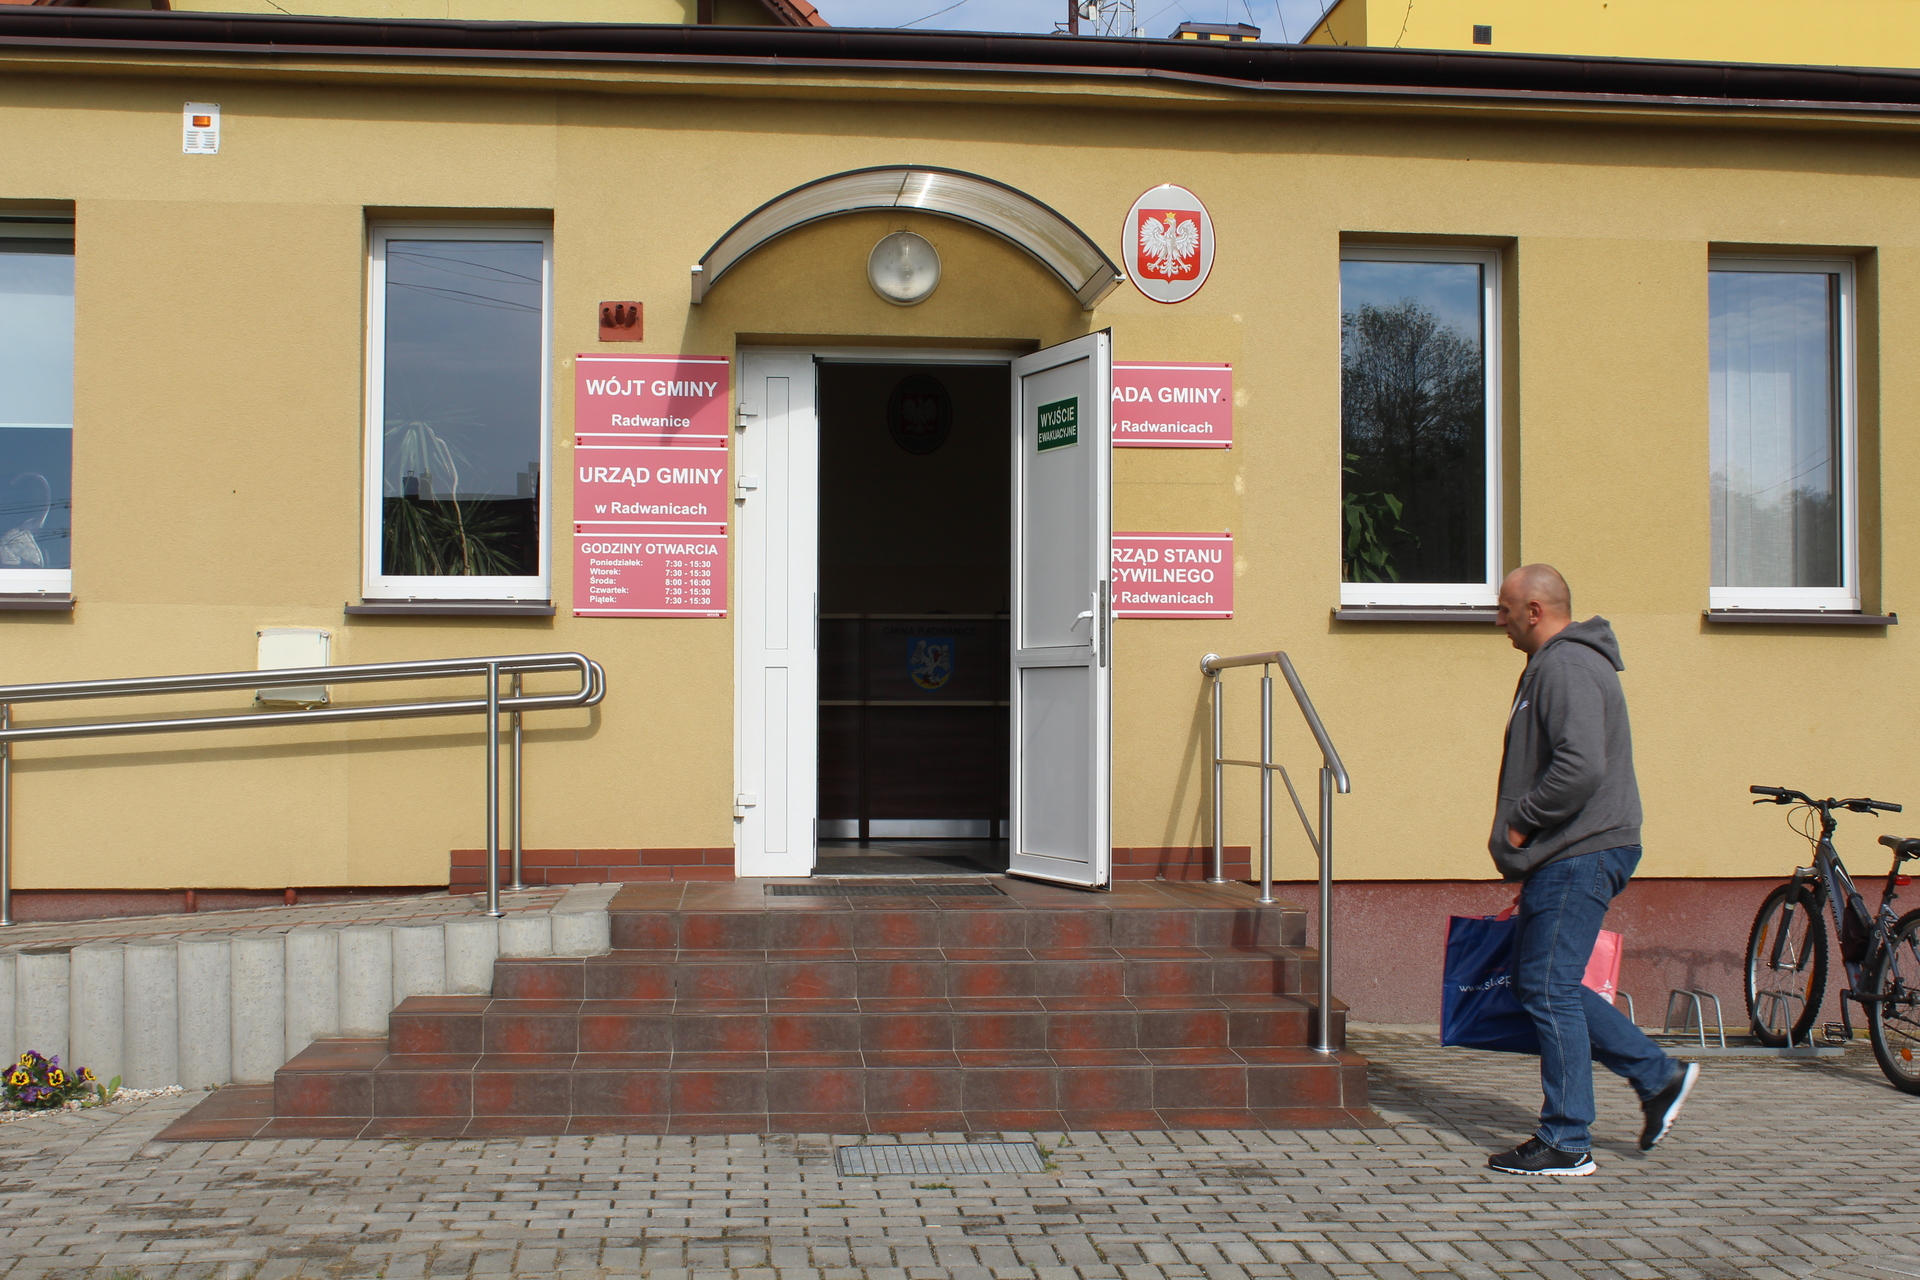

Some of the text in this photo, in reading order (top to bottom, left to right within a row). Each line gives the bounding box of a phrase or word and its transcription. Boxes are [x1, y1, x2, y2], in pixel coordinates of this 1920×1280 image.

[585, 375, 718, 397] WÓJT GMINY
[1111, 386, 1222, 404] ADA GMINY
[611, 414, 691, 428] Radwanice
[1040, 406, 1075, 428] WYJŚCIE
[1121, 420, 1213, 433] Radwanicach
[1038, 425, 1077, 443] EWAKUACYJNE
[579, 466, 724, 487] URZĄD GMINY
[594, 502, 707, 515] w Radwanicach
[581, 542, 719, 555] GODZINY OTWARCIA
[590, 558, 643, 567] Poniedziałek:
[690, 560, 711, 568] 15:30
[1111, 548, 1222, 566] RZĄD STANU
[590, 567, 621, 576] Wtorek:
[665, 569, 683, 577] 7:30
[690, 569, 711, 577] 15:30
[1111, 567, 1215, 583] CYWILNEGO
[590, 576, 616, 585] Środa:
[665, 578, 683, 586] 8:00
[690, 578, 711, 586] 16:00
[590, 586, 629, 594] Czwartek:
[590, 595, 617, 605] Piątek:
[690, 597, 711, 605] 15:30
[1121, 591, 1214, 604] Radwanicach
[883, 627, 977, 636] GMINA RADWANICE
